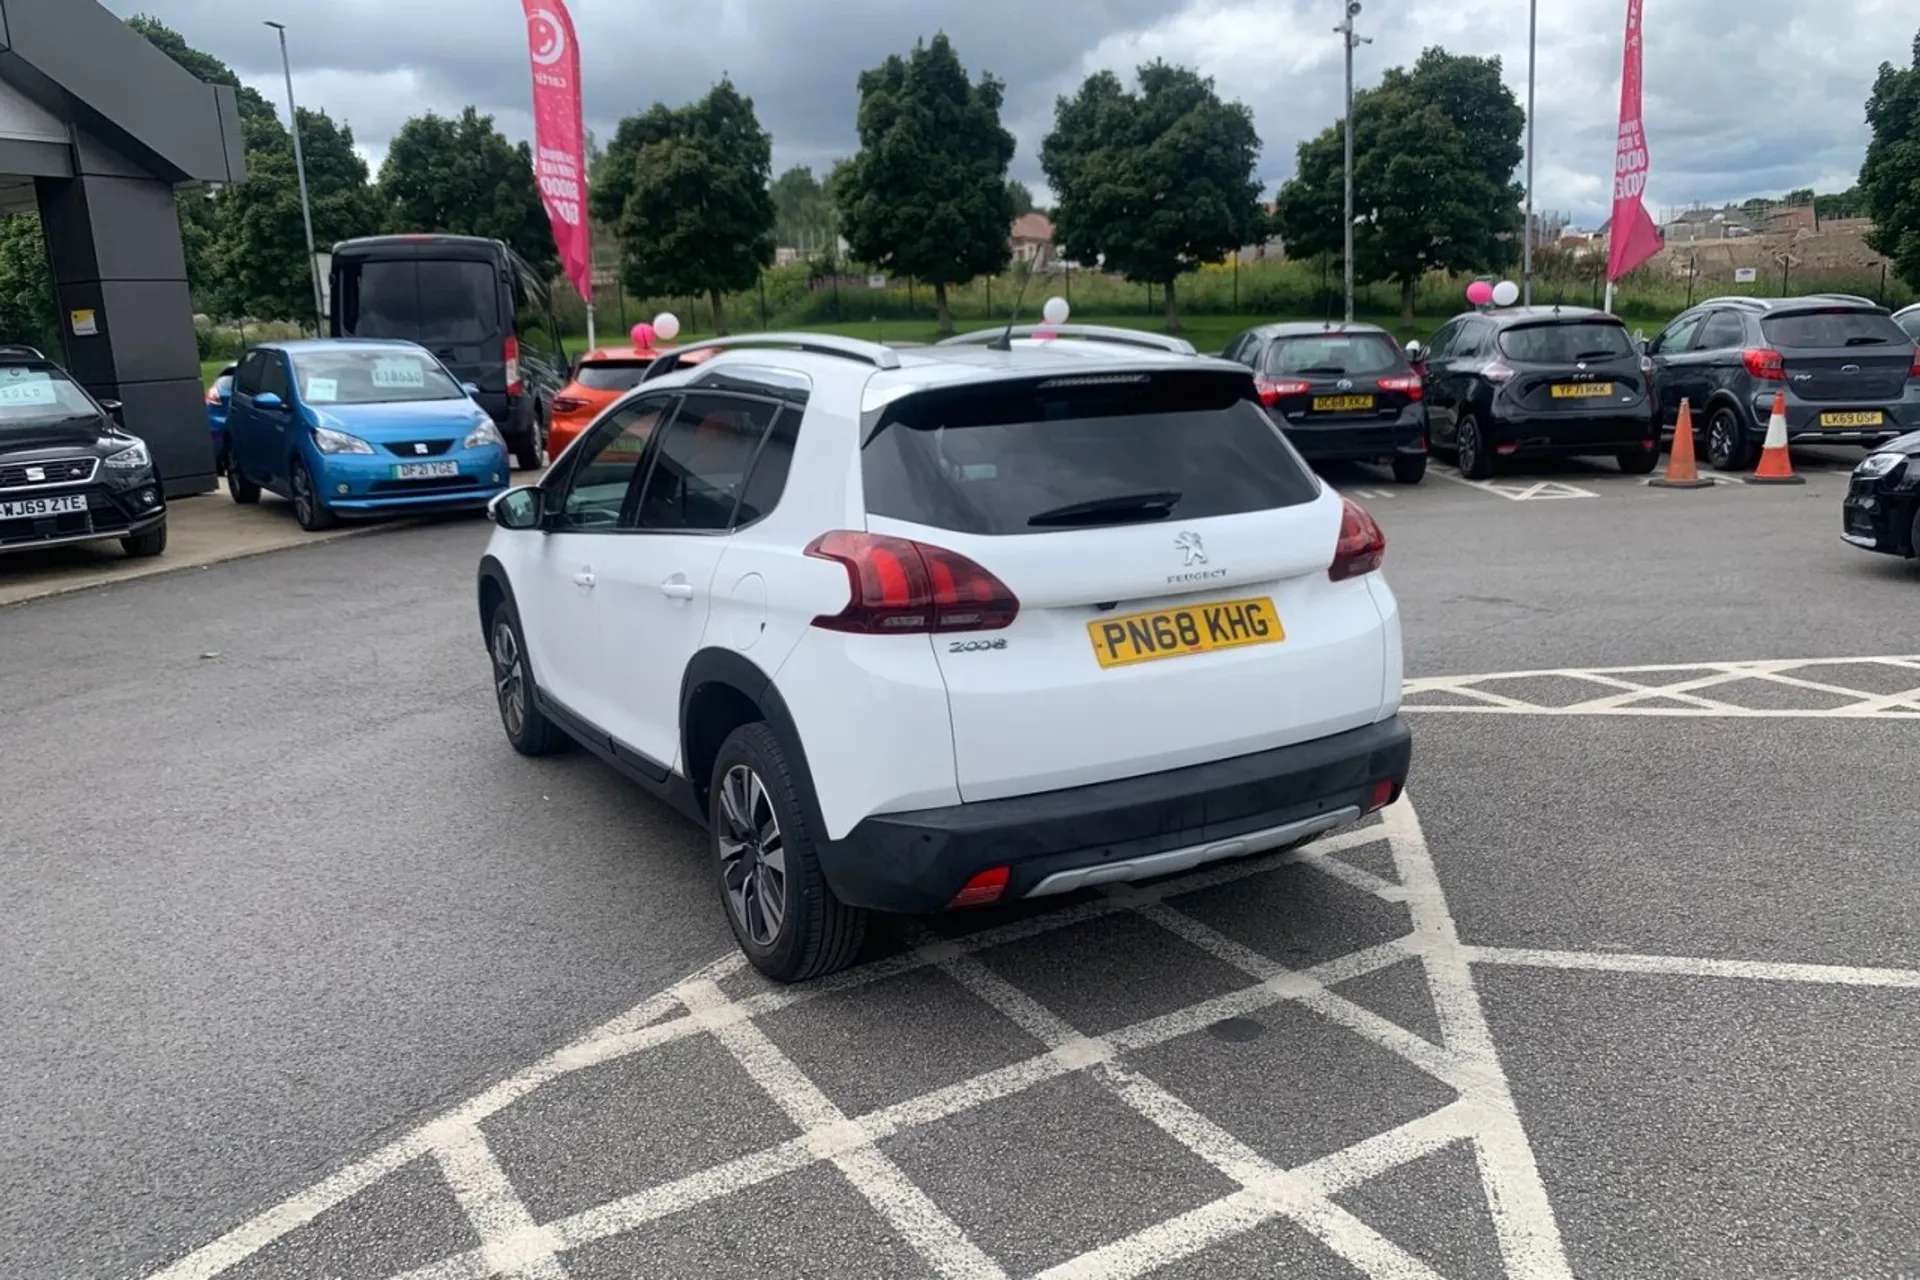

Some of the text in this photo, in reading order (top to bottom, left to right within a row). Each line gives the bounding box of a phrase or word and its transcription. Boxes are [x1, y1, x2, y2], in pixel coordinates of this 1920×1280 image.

[3, 496, 81, 517] WJ69 ZTE
[1103, 603, 1270, 660] PN68 KHG
[949, 638, 1008, 653] 2008
